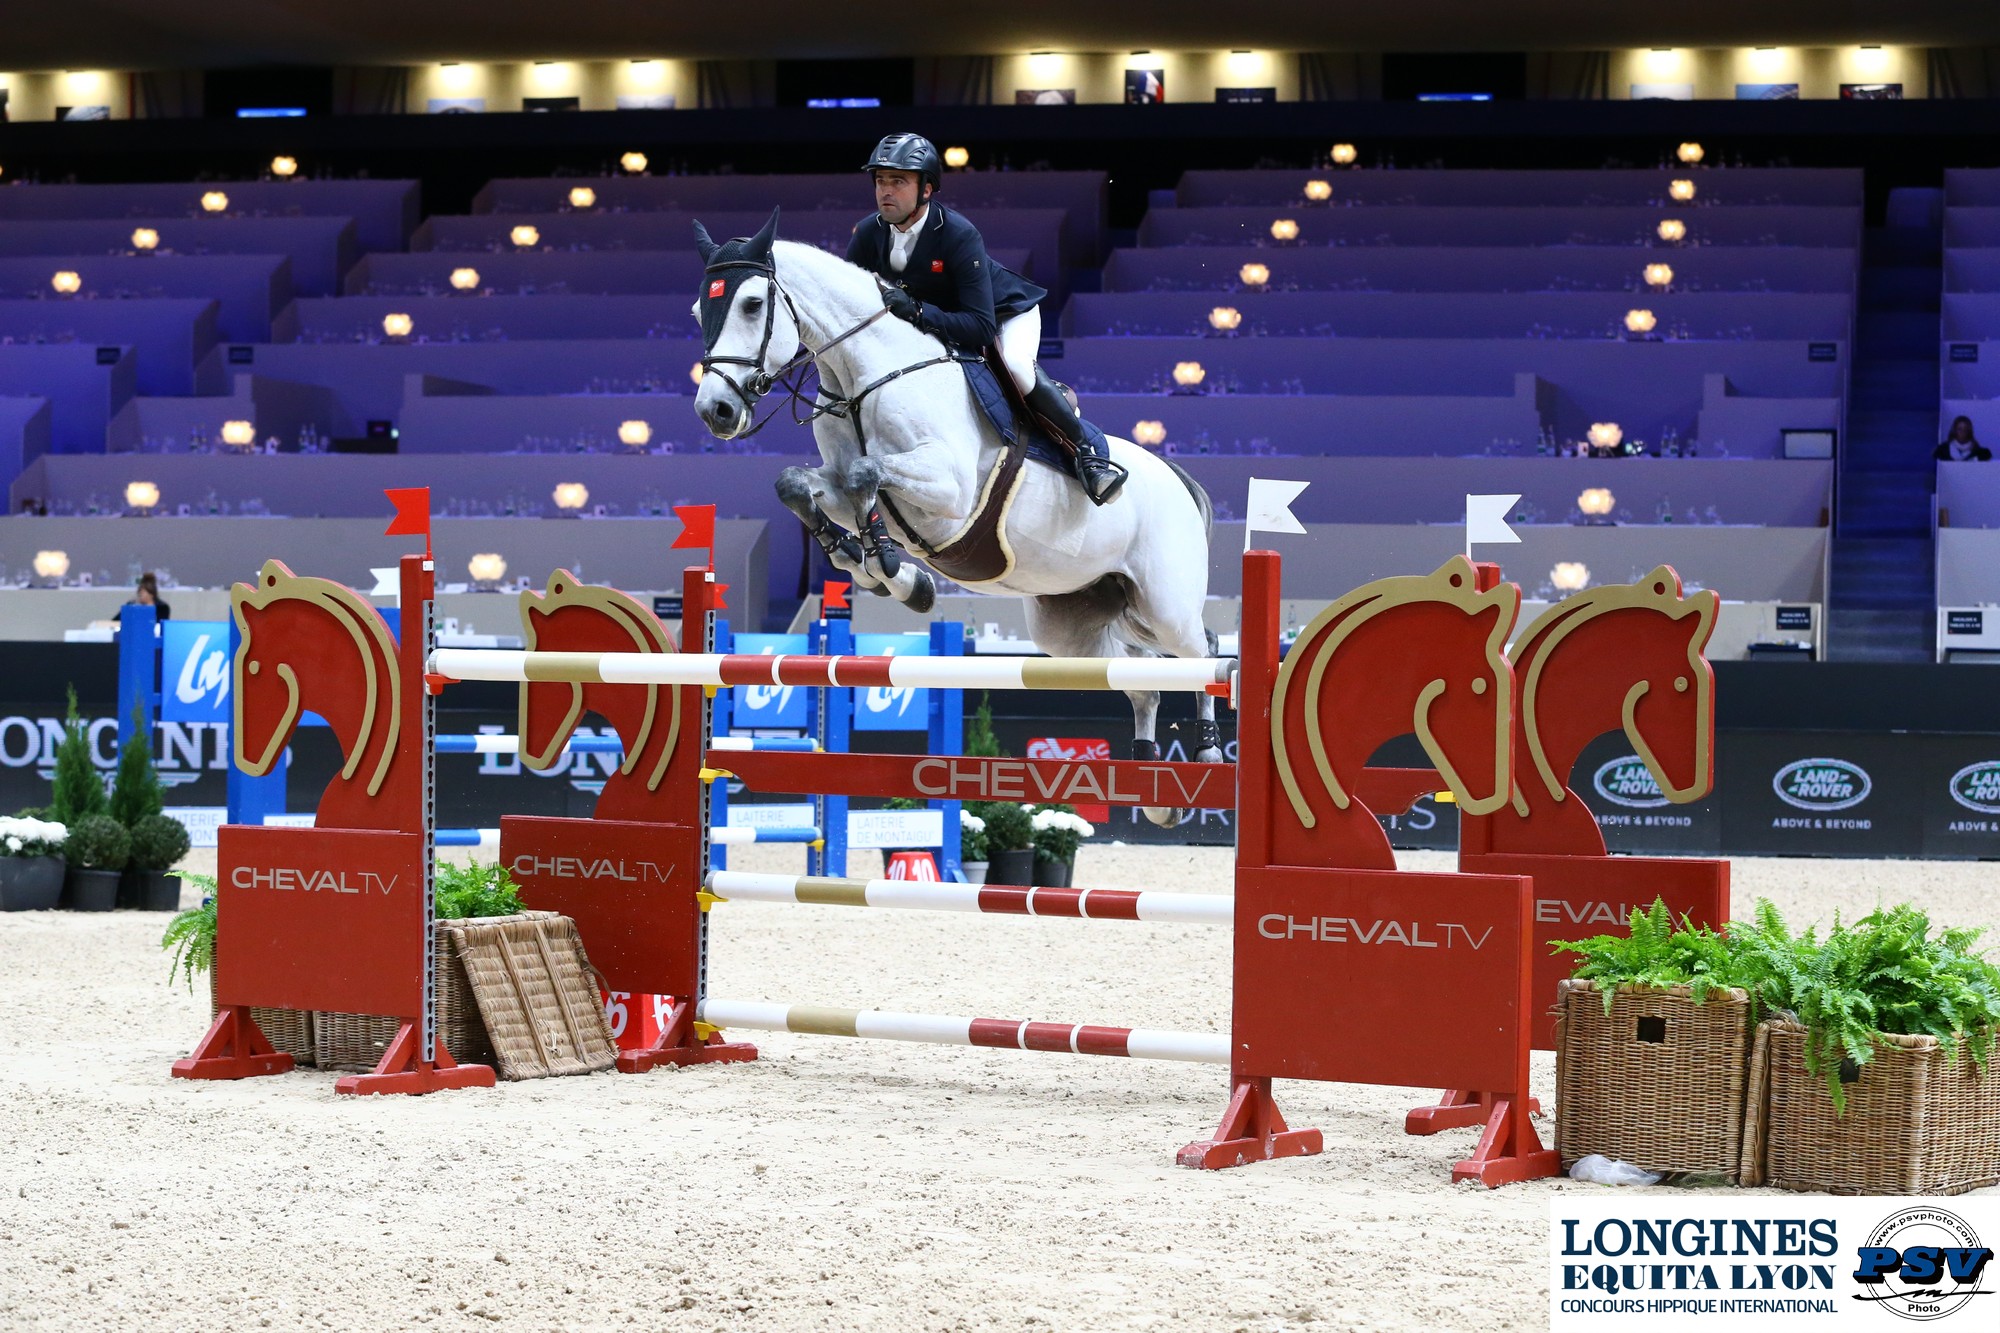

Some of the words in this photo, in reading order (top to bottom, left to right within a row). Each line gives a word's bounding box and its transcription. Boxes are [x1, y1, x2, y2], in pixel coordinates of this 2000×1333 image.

[1615, 766, 1656, 780] LAN
[1794, 768, 1840, 783] LAND
[1797, 783, 1853, 797] ROVER
[736, 810, 784, 822] LAITERIE
[1645, 816, 1692, 827] BEYOND
[857, 817, 905, 829] LAITERIE
[1772, 818, 1811, 828] ABOVE
[1814, 819, 1822, 829] &
[1826, 819, 1872, 830] BEYOND
[1949, 821, 1987, 831] ABOVE
[857, 831, 871, 844] DE
